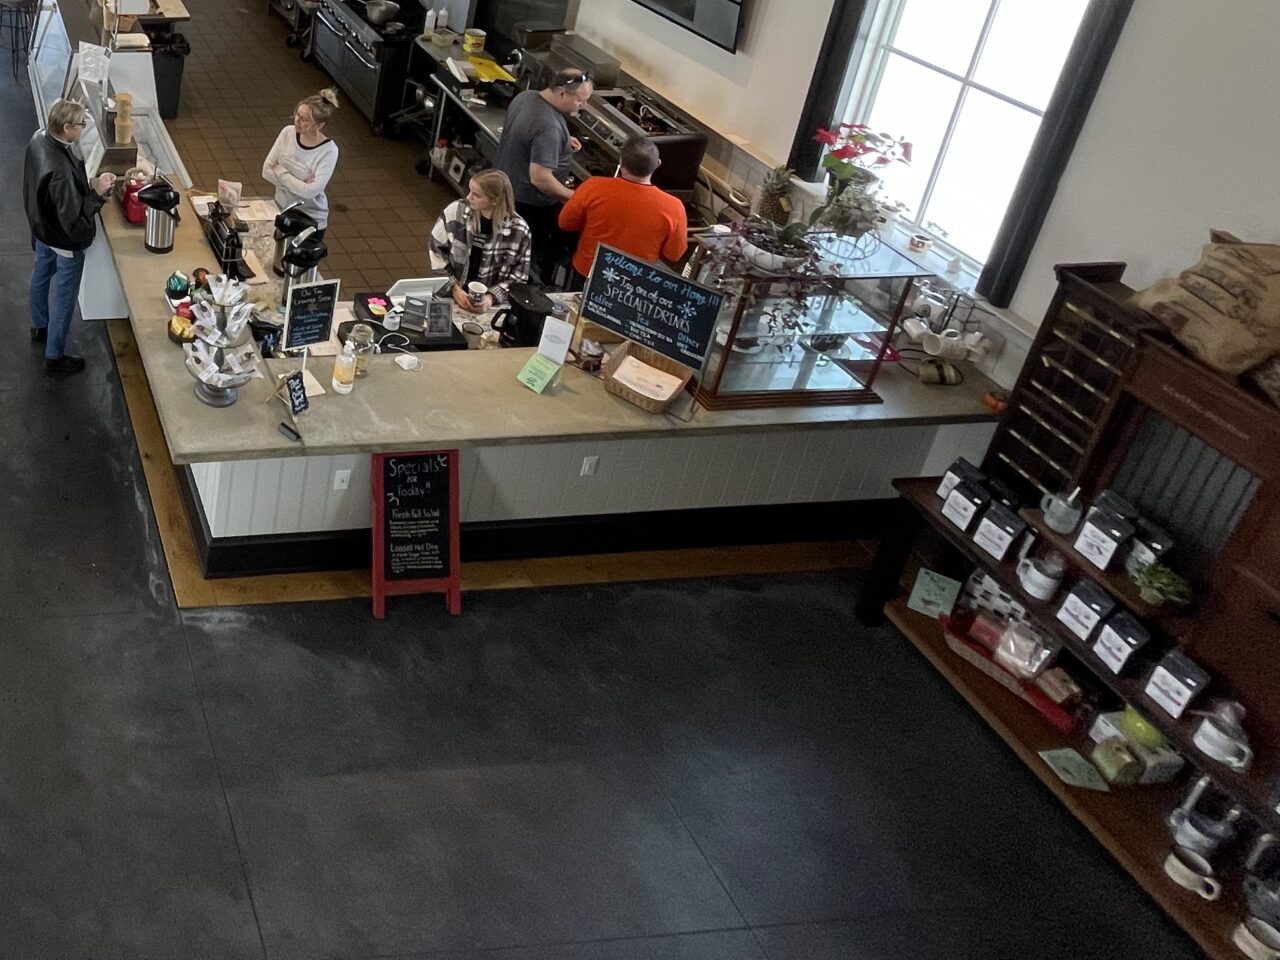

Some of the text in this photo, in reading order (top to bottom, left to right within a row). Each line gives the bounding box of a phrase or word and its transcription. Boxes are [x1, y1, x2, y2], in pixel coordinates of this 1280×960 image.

[604, 252, 643, 276] Welcome
[648, 269, 663, 283] to
[663, 280, 678, 291] our
[620, 275, 634, 296] Try
[648, 290, 658, 304] of
[659, 296, 674, 308] our
[603, 284, 654, 316] SPECIALTY
[654, 308, 691, 333] DRINKS
[677, 332, 700, 348] Other
[389, 458, 439, 477] Specials
